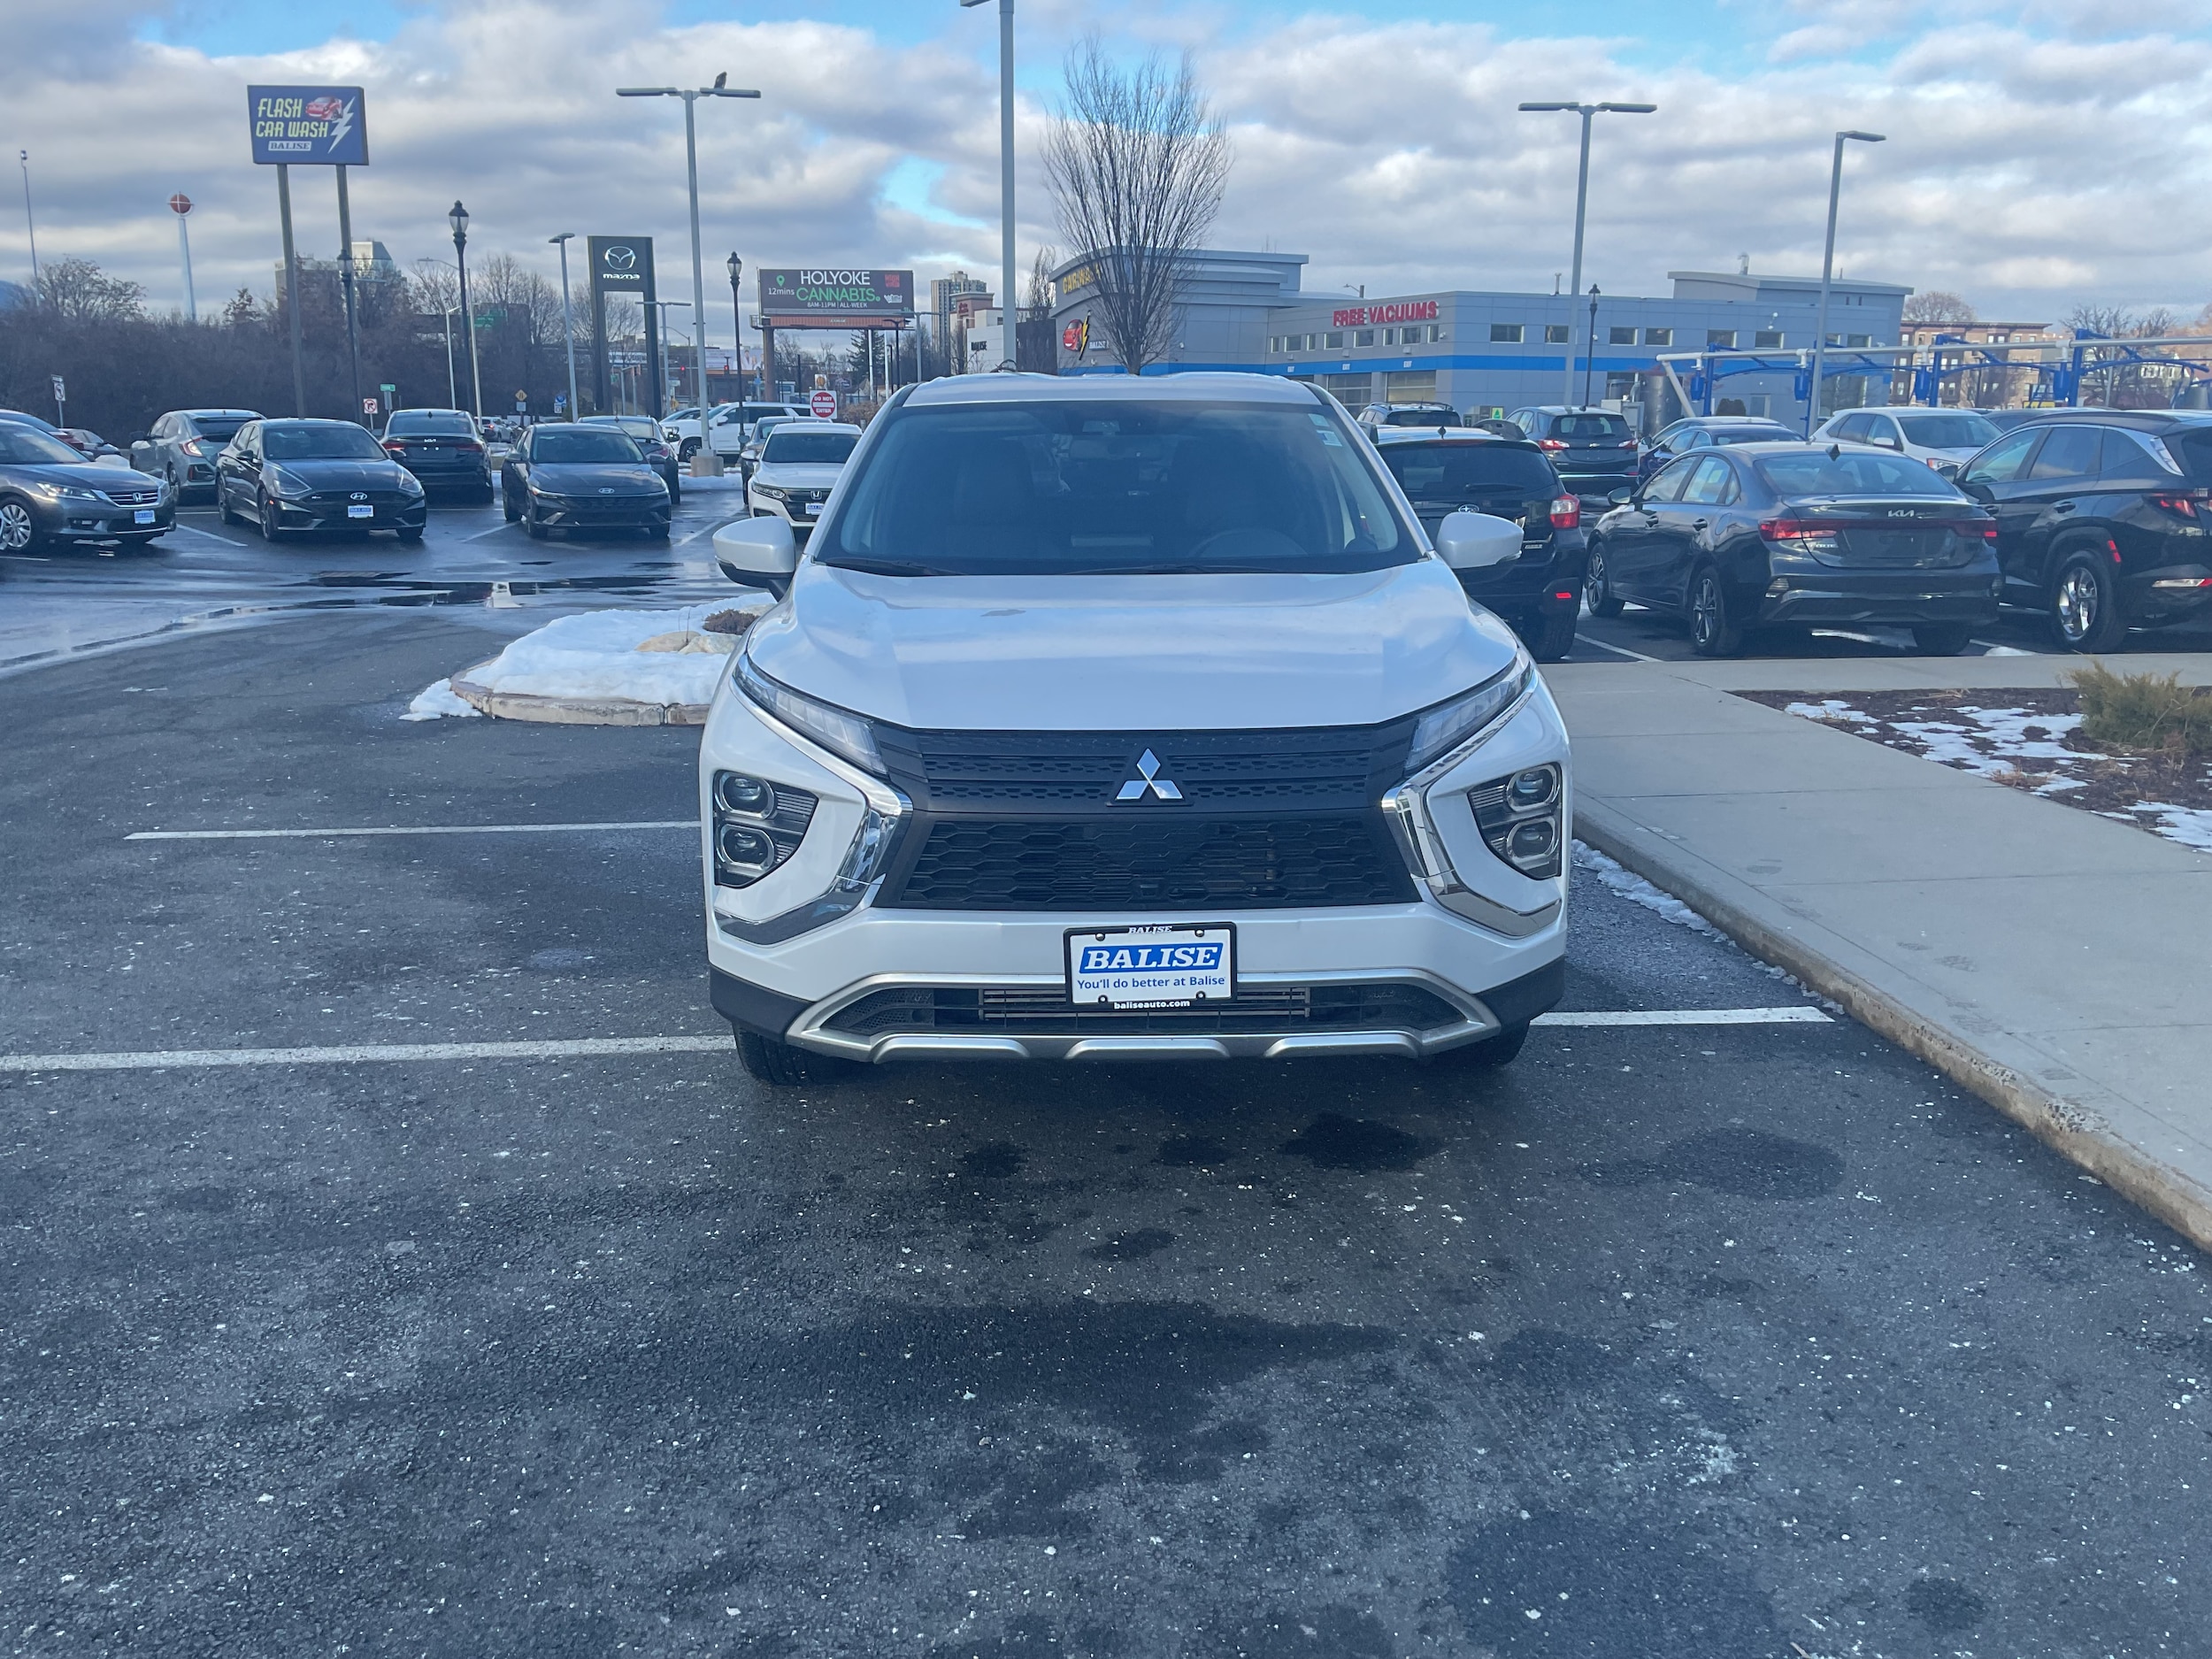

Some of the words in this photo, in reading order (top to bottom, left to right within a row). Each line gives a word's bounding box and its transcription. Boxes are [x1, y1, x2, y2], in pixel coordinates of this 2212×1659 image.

[257, 98, 303, 118] FLASH
[256, 121, 284, 137] CAR
[288, 121, 328, 137] WASH
[801, 271, 871, 285] HOLYOKE
[1333, 308, 1367, 326] FREE
[1368, 301, 1440, 323] VACUUMS
[1128, 926, 1172, 934] BALISE
[1084, 946, 1218, 970] BALISE
[1113, 978, 1128, 988] do
[1132, 977, 1170, 987] better
[1173, 977, 1186, 986] at
[1189, 975, 1225, 986] Balise
[1113, 1000, 1191, 1010] baliseauto.com
